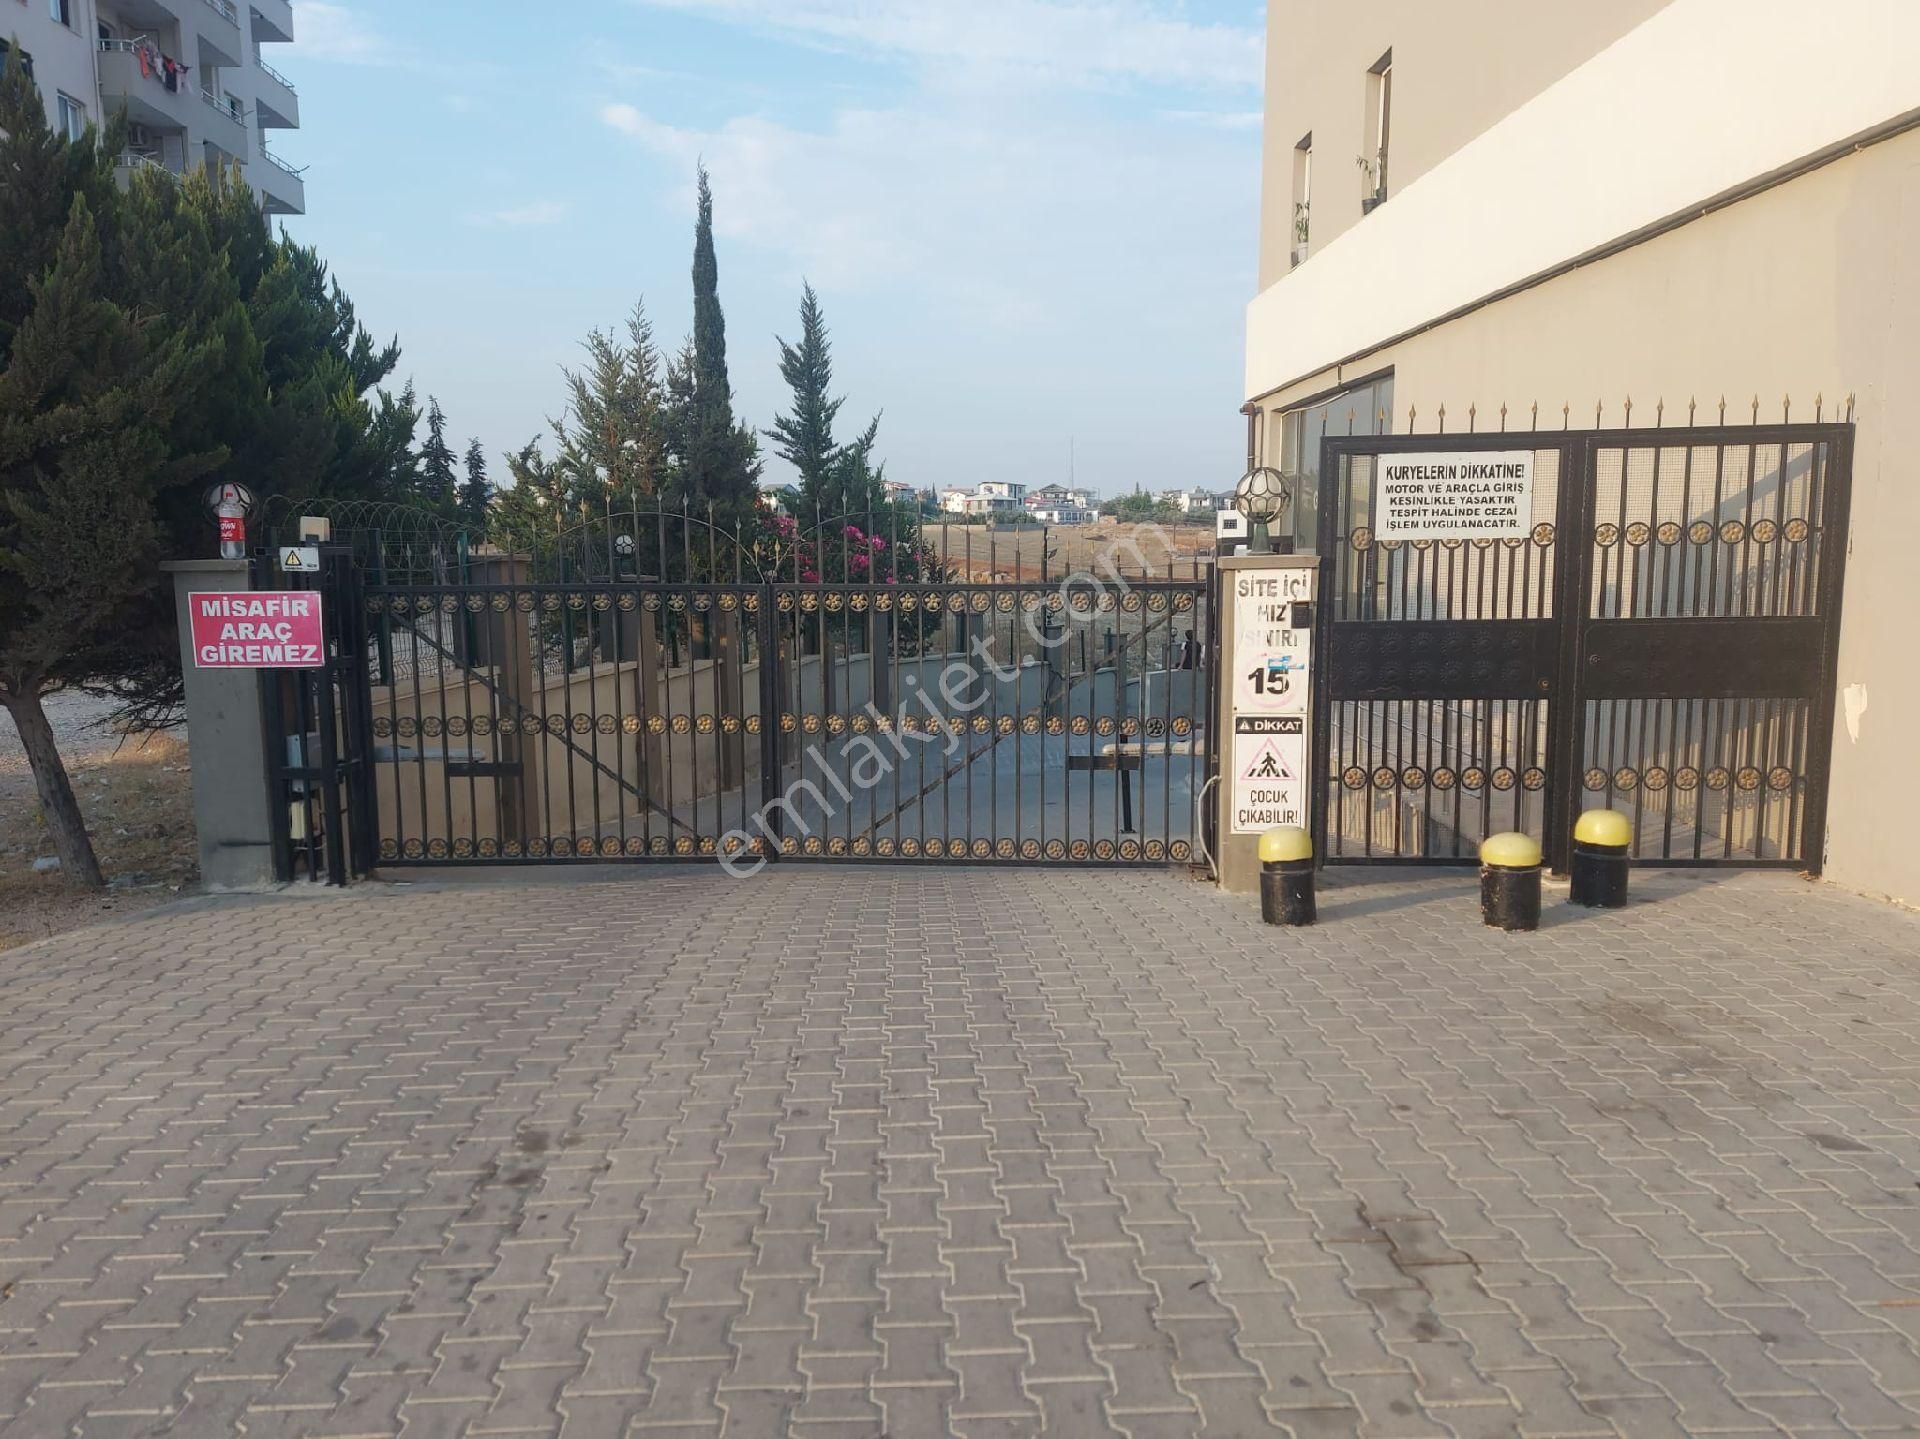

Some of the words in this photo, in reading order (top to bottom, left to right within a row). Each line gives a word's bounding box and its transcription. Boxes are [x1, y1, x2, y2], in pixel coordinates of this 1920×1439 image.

[1460, 462, 1525, 479] DİKKATİNE!
[1385, 484, 1424, 494] MOTOR
[1428, 484, 1442, 493] VE
[1446, 484, 1490, 495] ARAÇLA
[1494, 482, 1524, 494] GİRİŞ
[1460, 496, 1515, 505] YASAKTIR
[1389, 507, 1429, 517] TESPİT
[1432, 507, 1480, 516] HALİNDE
[1485, 505, 1517, 515] CEZAİ
[1386, 519, 1419, 531] İŞLEM
[1238, 575, 1278, 597] SİTE
[201, 596, 310, 617] MİSAFİR
[220, 622, 293, 644] ARAÇ
[201, 642, 319, 663] GİREMEZ
[1248, 667, 1290, 695] 15
[1254, 719, 1301, 731] DİKKAT
[1250, 790, 1289, 806] ÇOCUK
